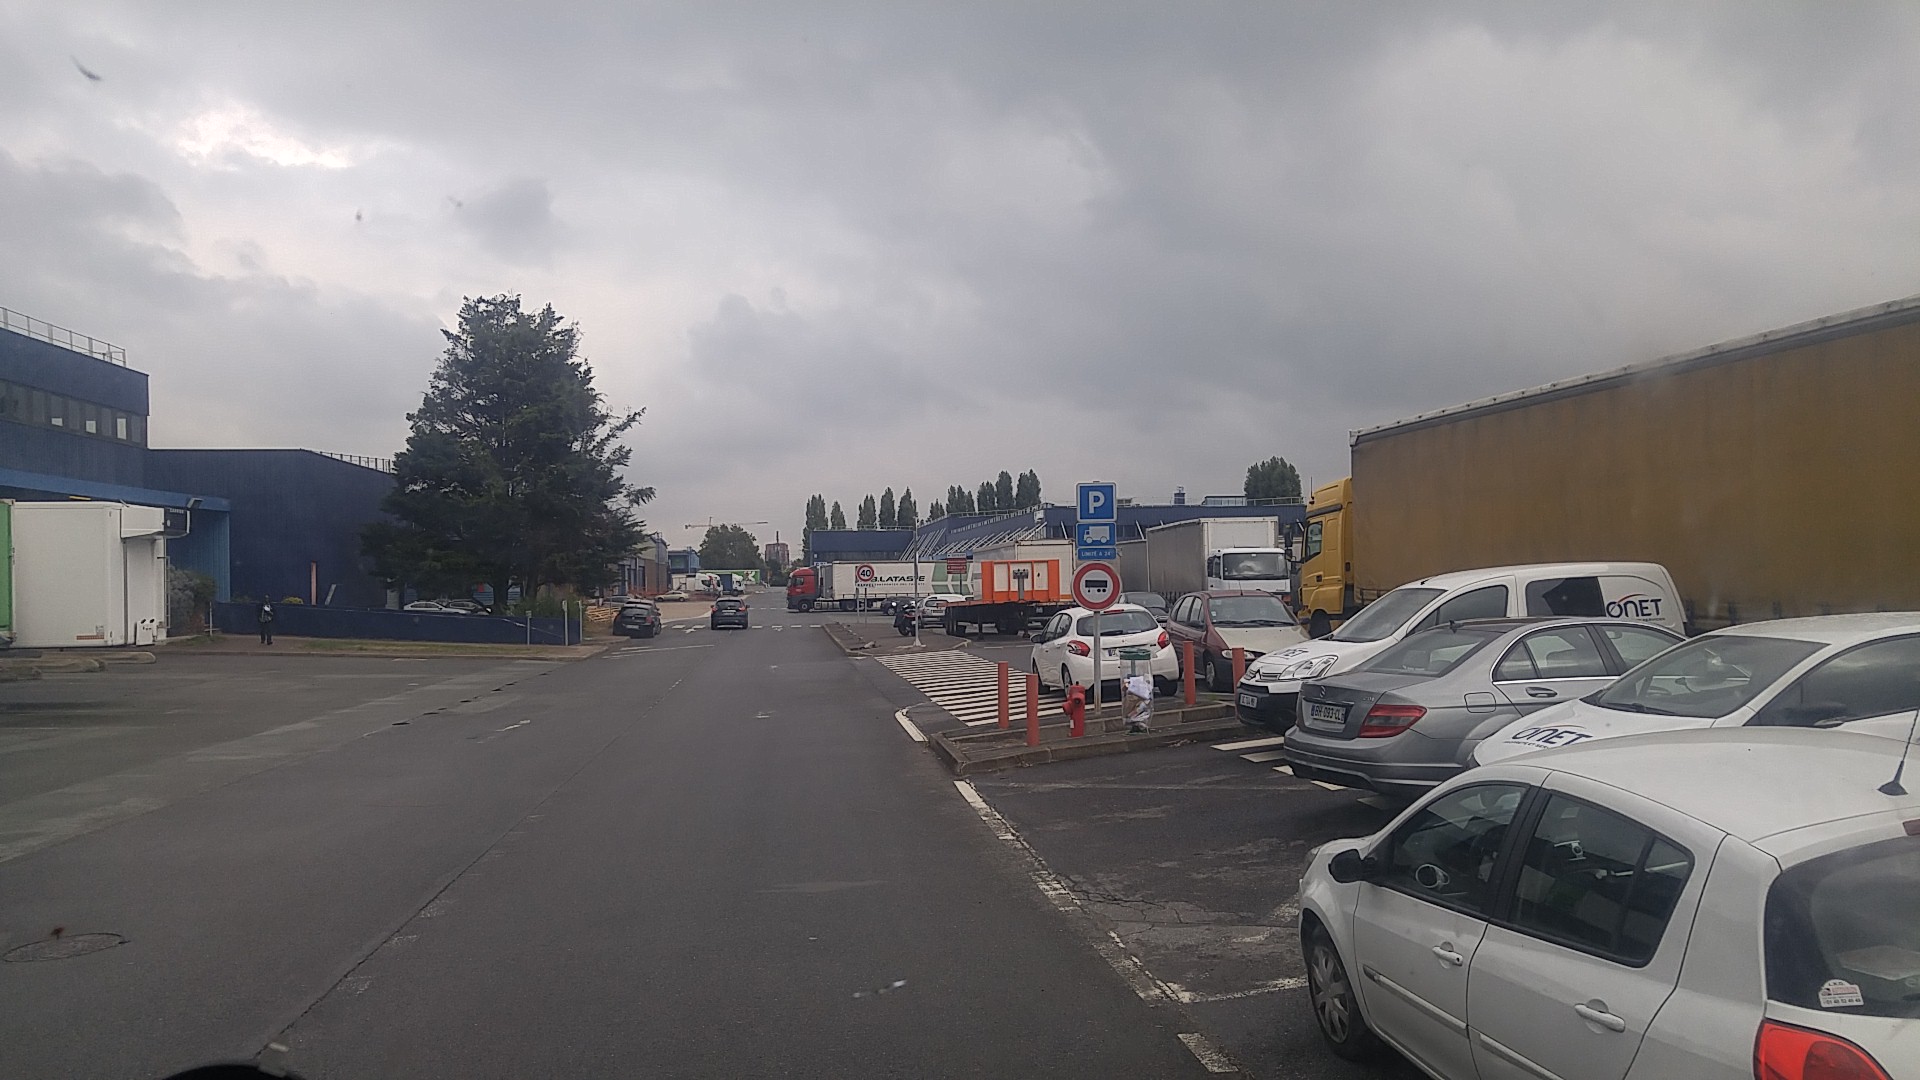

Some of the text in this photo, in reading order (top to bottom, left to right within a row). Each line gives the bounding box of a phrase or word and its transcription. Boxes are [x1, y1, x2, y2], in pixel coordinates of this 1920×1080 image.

[1088, 491, 1105, 514] P
[861, 569, 871, 577] 40
[1606, 599, 1662, 618] ONET
[1512, 727, 1593, 746] ONET
